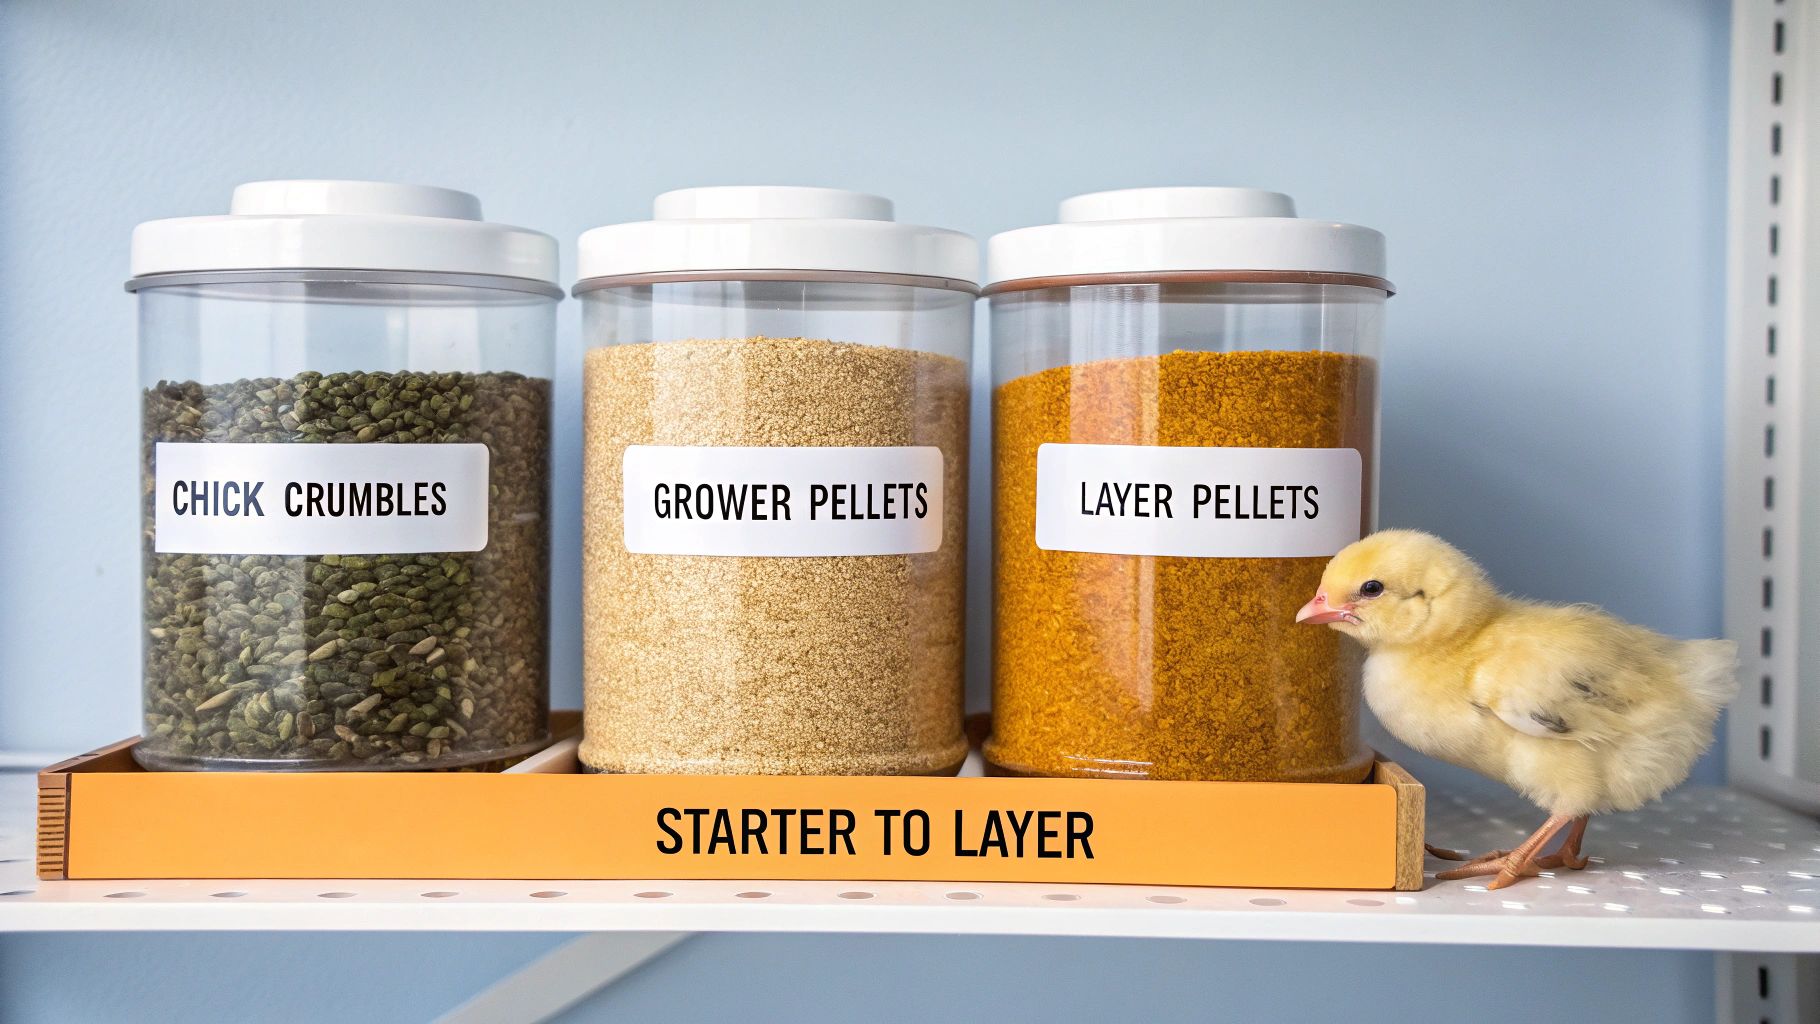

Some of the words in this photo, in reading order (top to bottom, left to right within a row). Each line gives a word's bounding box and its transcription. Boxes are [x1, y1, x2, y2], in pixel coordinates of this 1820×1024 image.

[172, 480, 265, 517] CHICK
[284, 482, 447, 518] CRUMBLES
[653, 482, 792, 520] GROWER
[810, 481, 929, 520] PELLETS
[1080, 481, 1174, 519] LAYER
[1193, 483, 1320, 520] PELLETS
[655, 807, 857, 857] STARTER
[874, 808, 930, 857] TO
[954, 809, 1095, 860] LAYER
